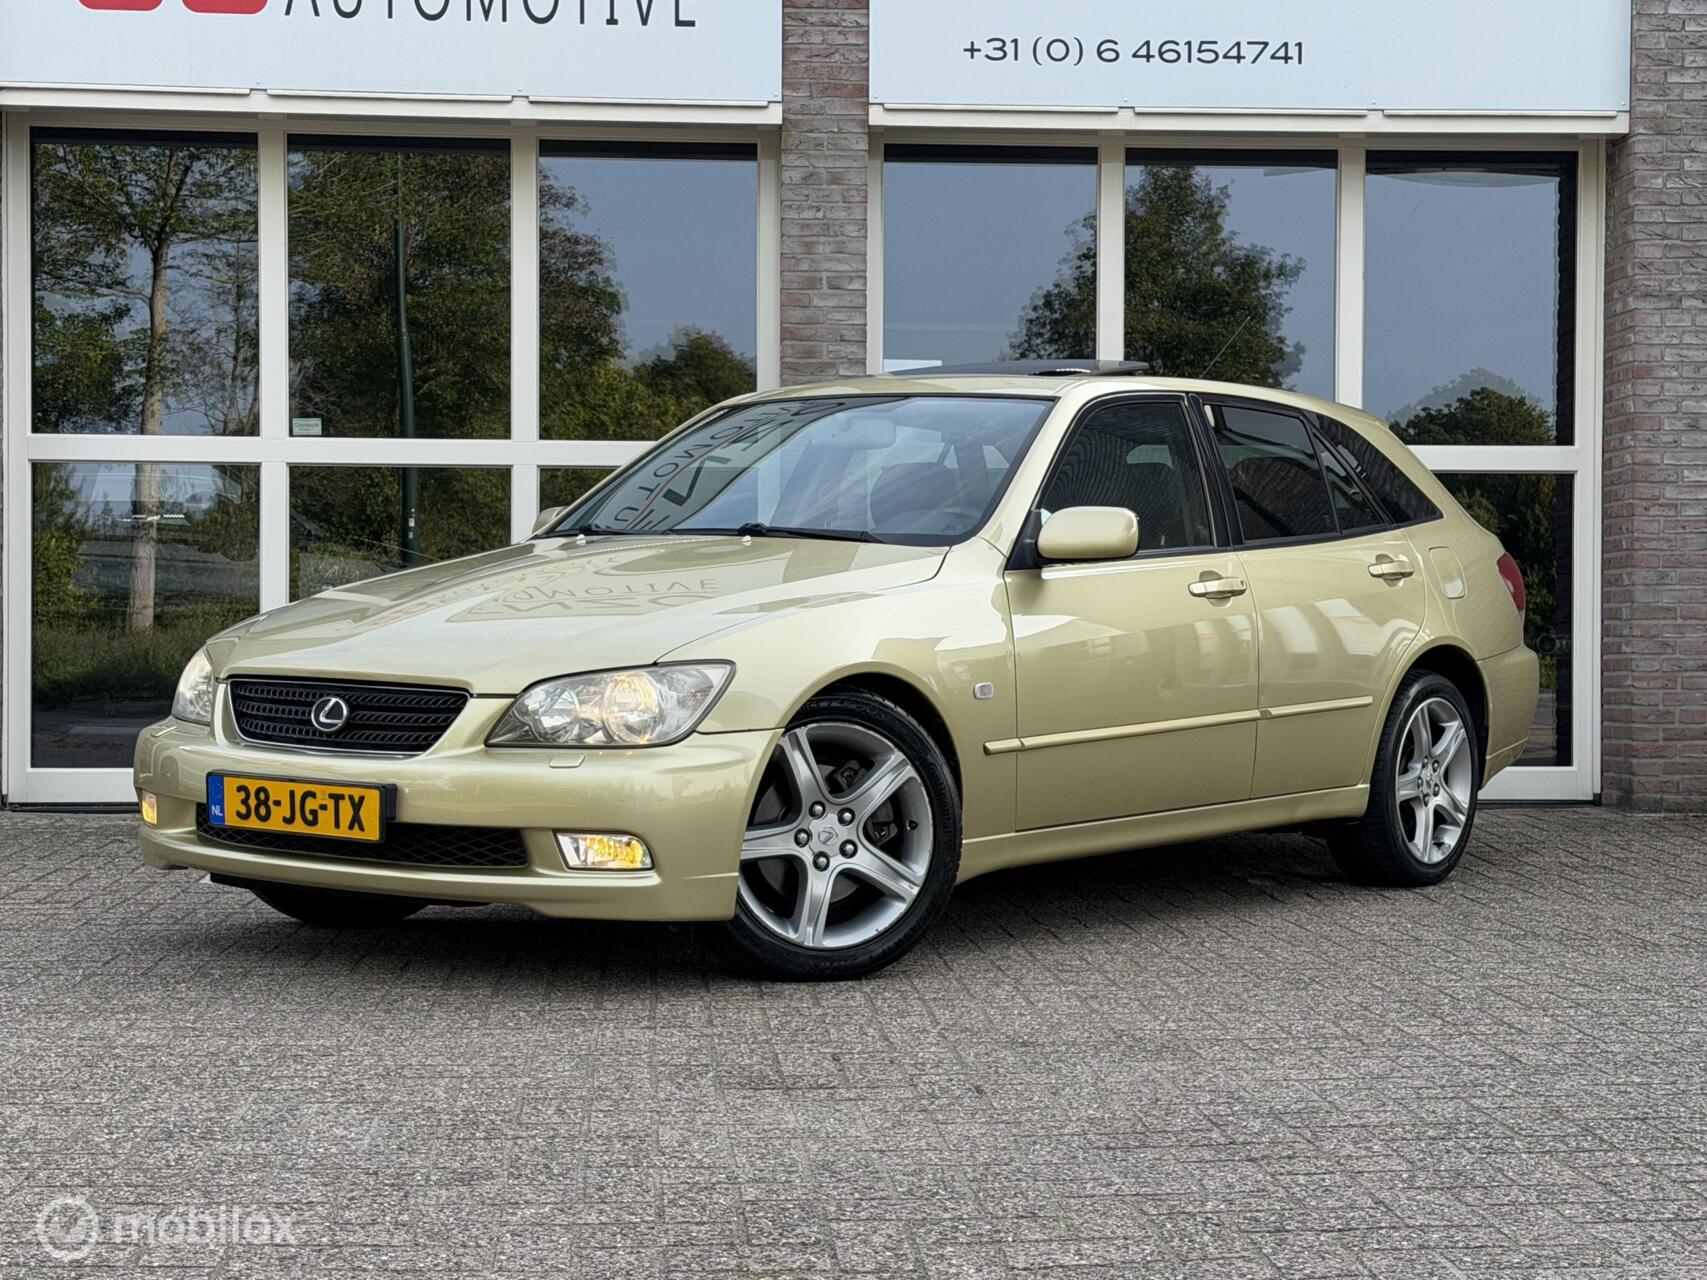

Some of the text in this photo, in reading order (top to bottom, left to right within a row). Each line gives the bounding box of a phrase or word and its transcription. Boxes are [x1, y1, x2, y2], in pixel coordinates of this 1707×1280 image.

[962, 36, 1304, 66] +31 (0) 6 46154741
[211, 804, 223, 817] NL
[235, 784, 366, 833] 38-JG-TX
